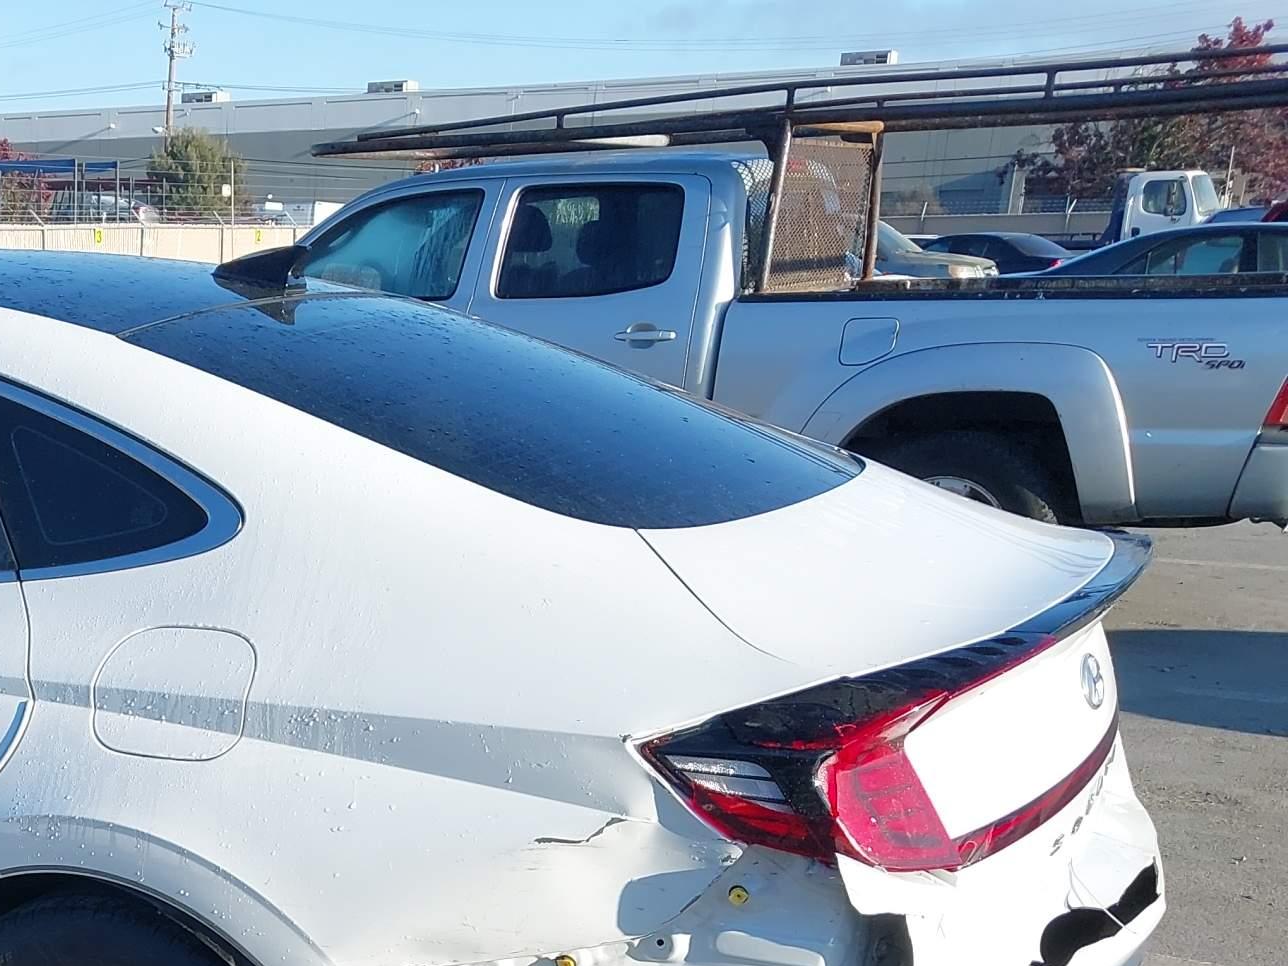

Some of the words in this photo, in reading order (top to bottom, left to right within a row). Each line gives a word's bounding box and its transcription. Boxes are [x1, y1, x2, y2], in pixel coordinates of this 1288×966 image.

[96, 230, 102, 243] 3
[256, 230, 262, 241] 2
[1146, 343, 1230, 363] TRD
